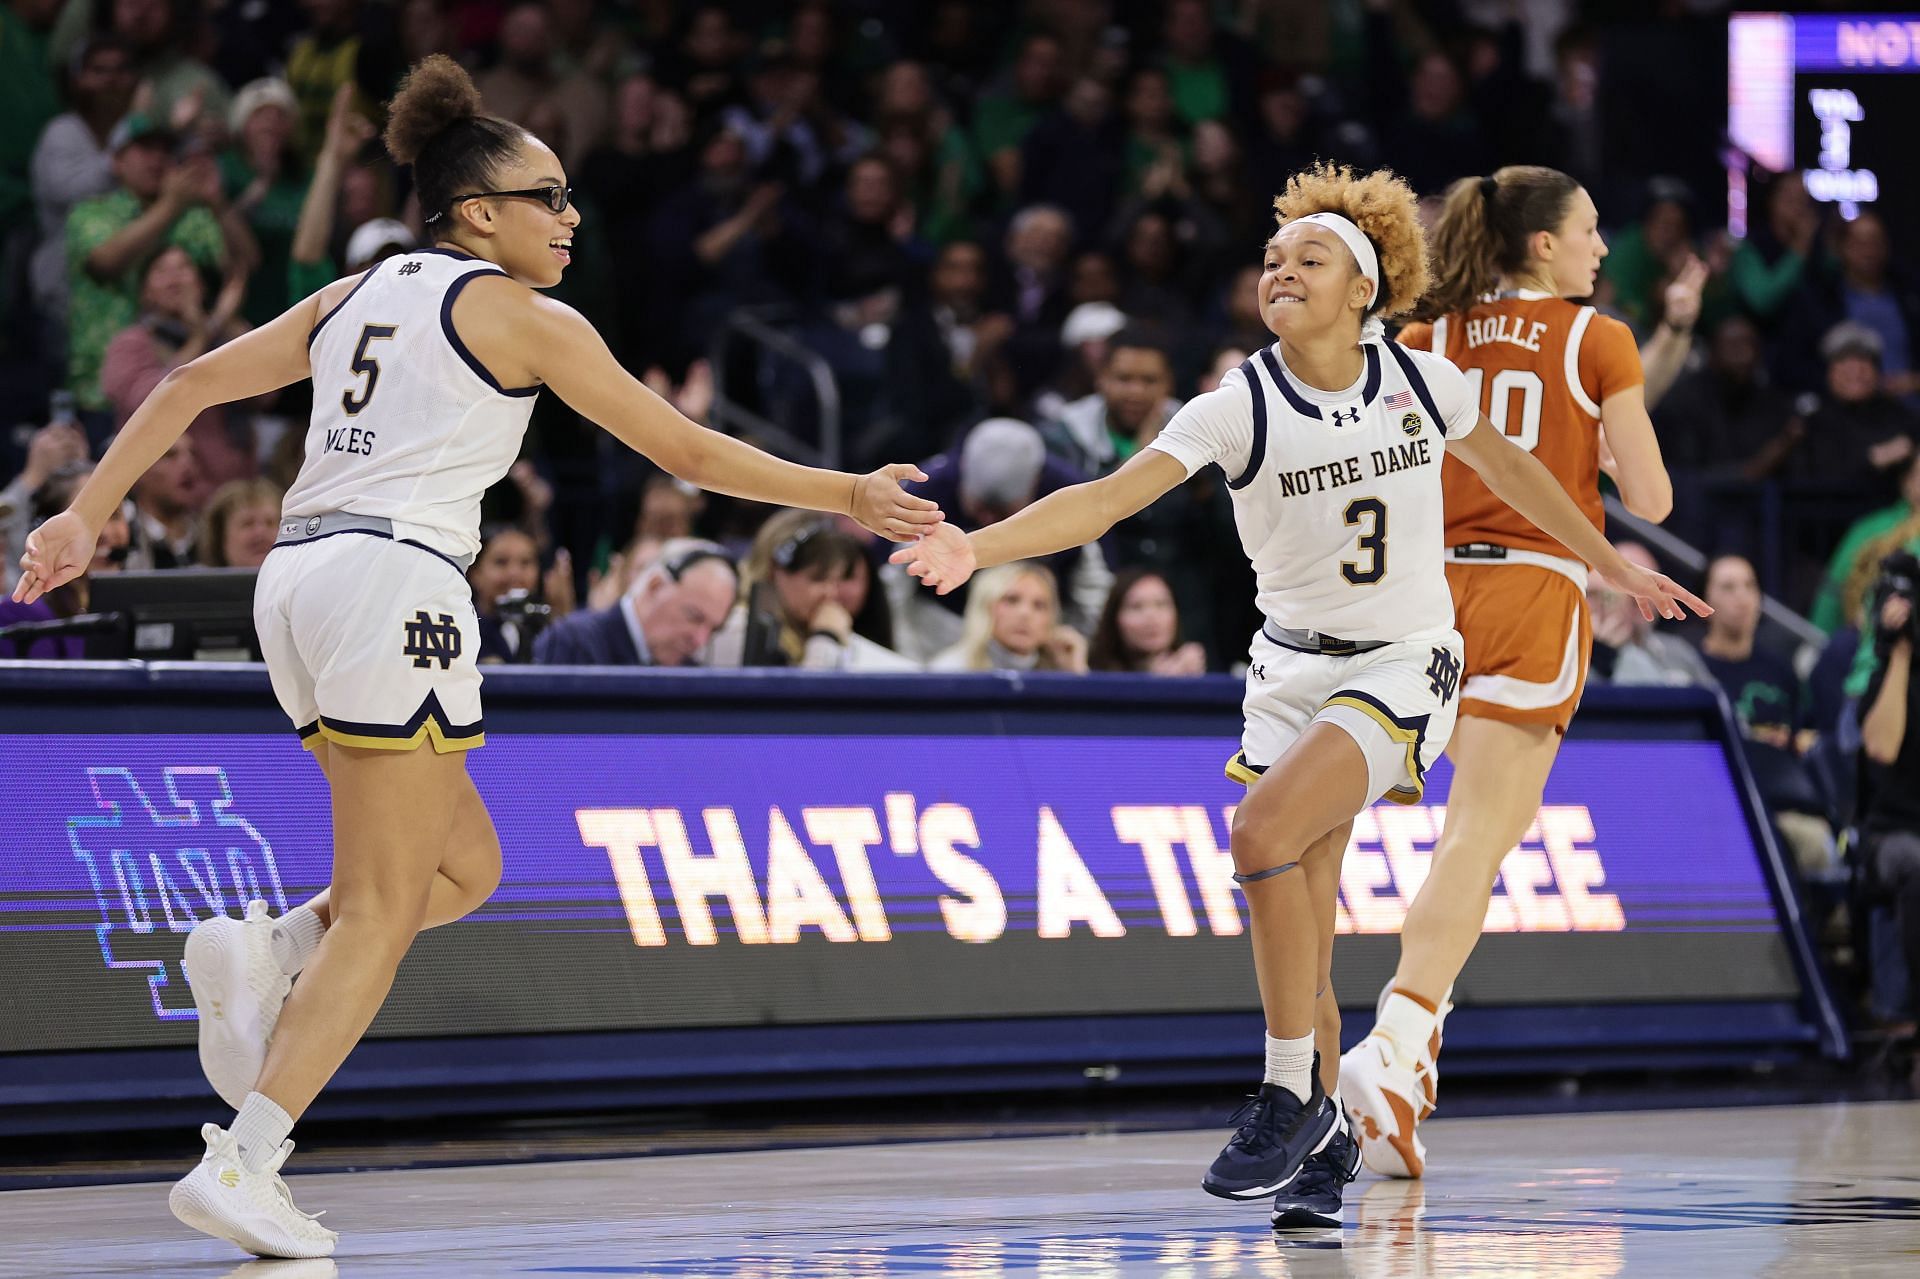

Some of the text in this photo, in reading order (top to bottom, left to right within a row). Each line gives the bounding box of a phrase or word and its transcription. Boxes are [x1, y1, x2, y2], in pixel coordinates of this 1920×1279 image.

[341, 322, 400, 417] 5
[1465, 314, 1548, 353] HOLLE
[1278, 438, 1432, 498] NOTRE DAME
[1339, 496, 1389, 587] 3
[575, 790, 1008, 946] THAT'S
[1038, 804, 1127, 938] A
